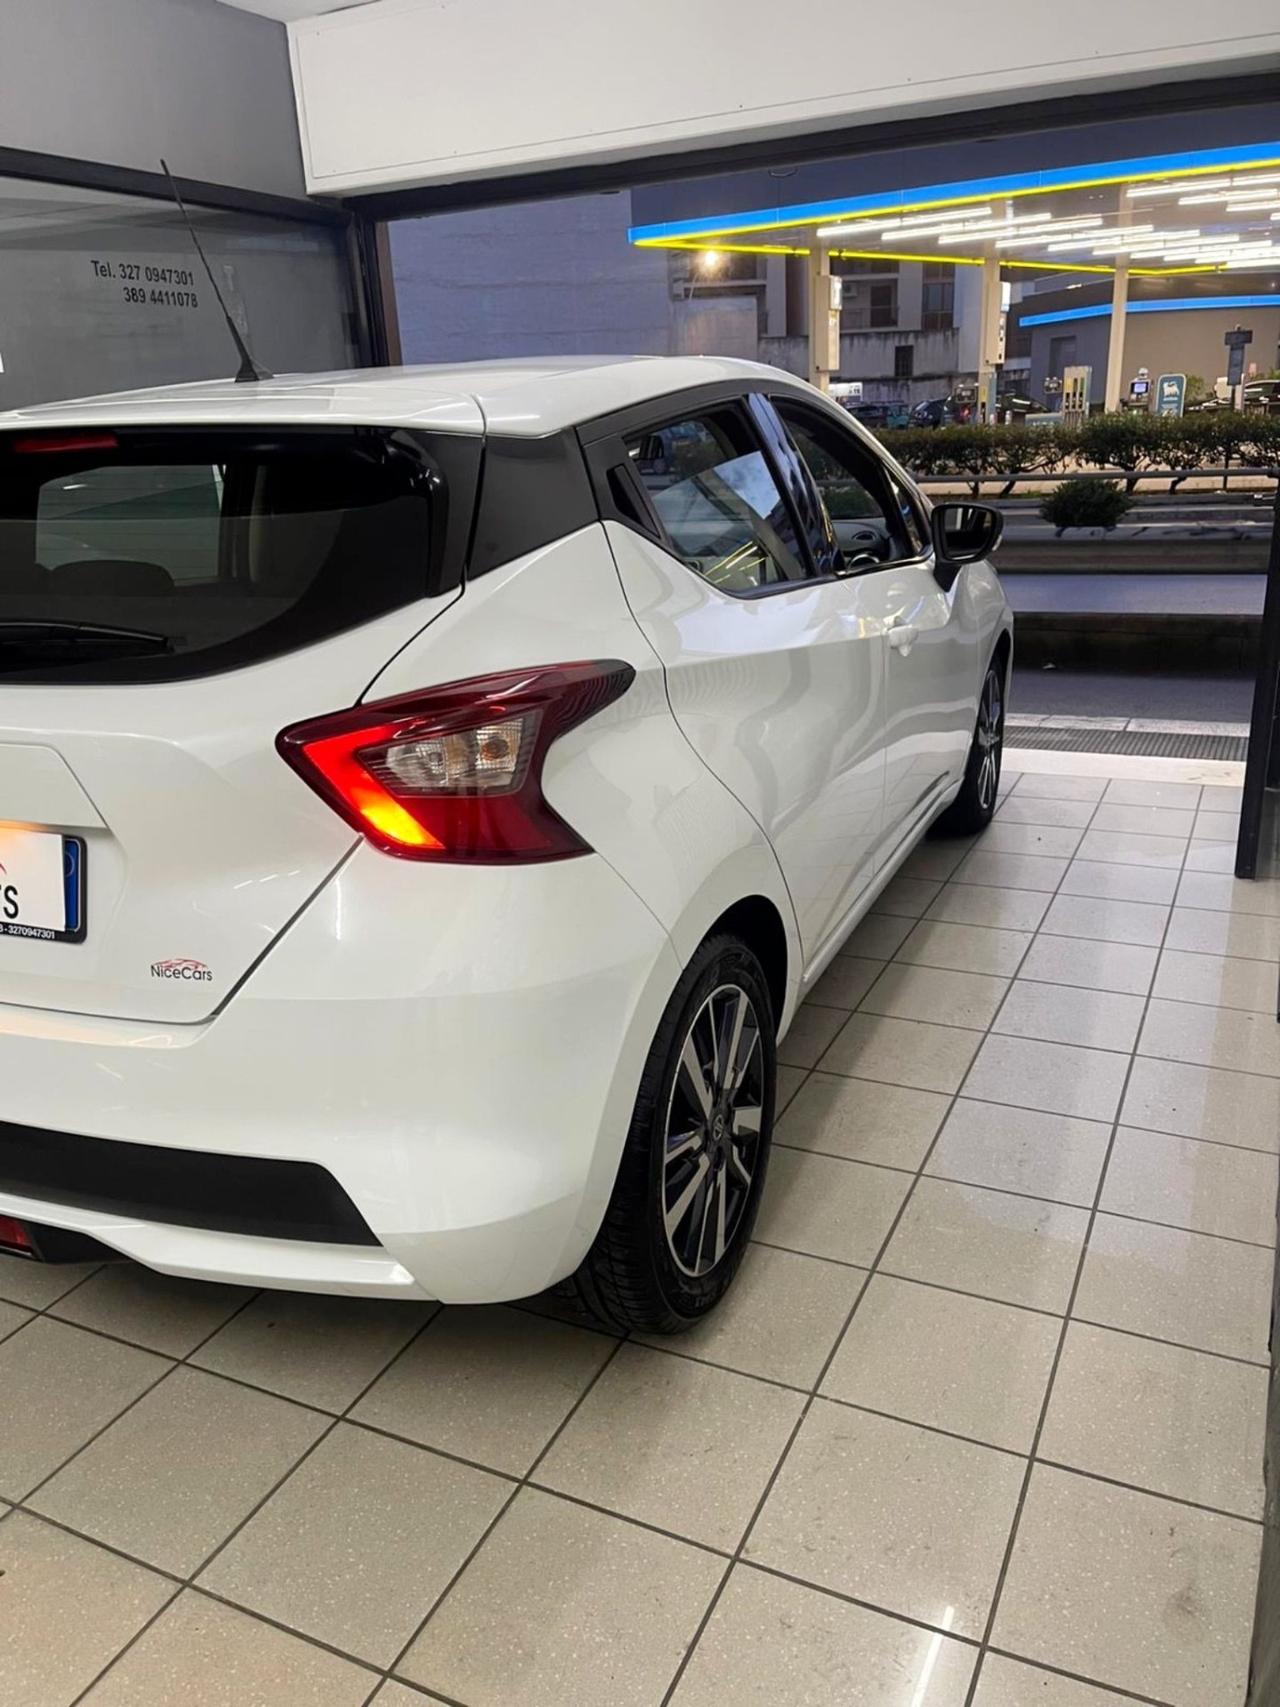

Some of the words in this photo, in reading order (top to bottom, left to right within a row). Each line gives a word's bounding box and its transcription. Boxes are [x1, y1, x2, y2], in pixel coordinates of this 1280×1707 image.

[91, 260, 116, 278] Tel.
[119, 263, 140, 280] 327
[145, 266, 194, 286] 0947301
[123, 286, 146, 304] 389
[150, 289, 198, 308] 4411078
[150, 965, 213, 981] NiceCars
